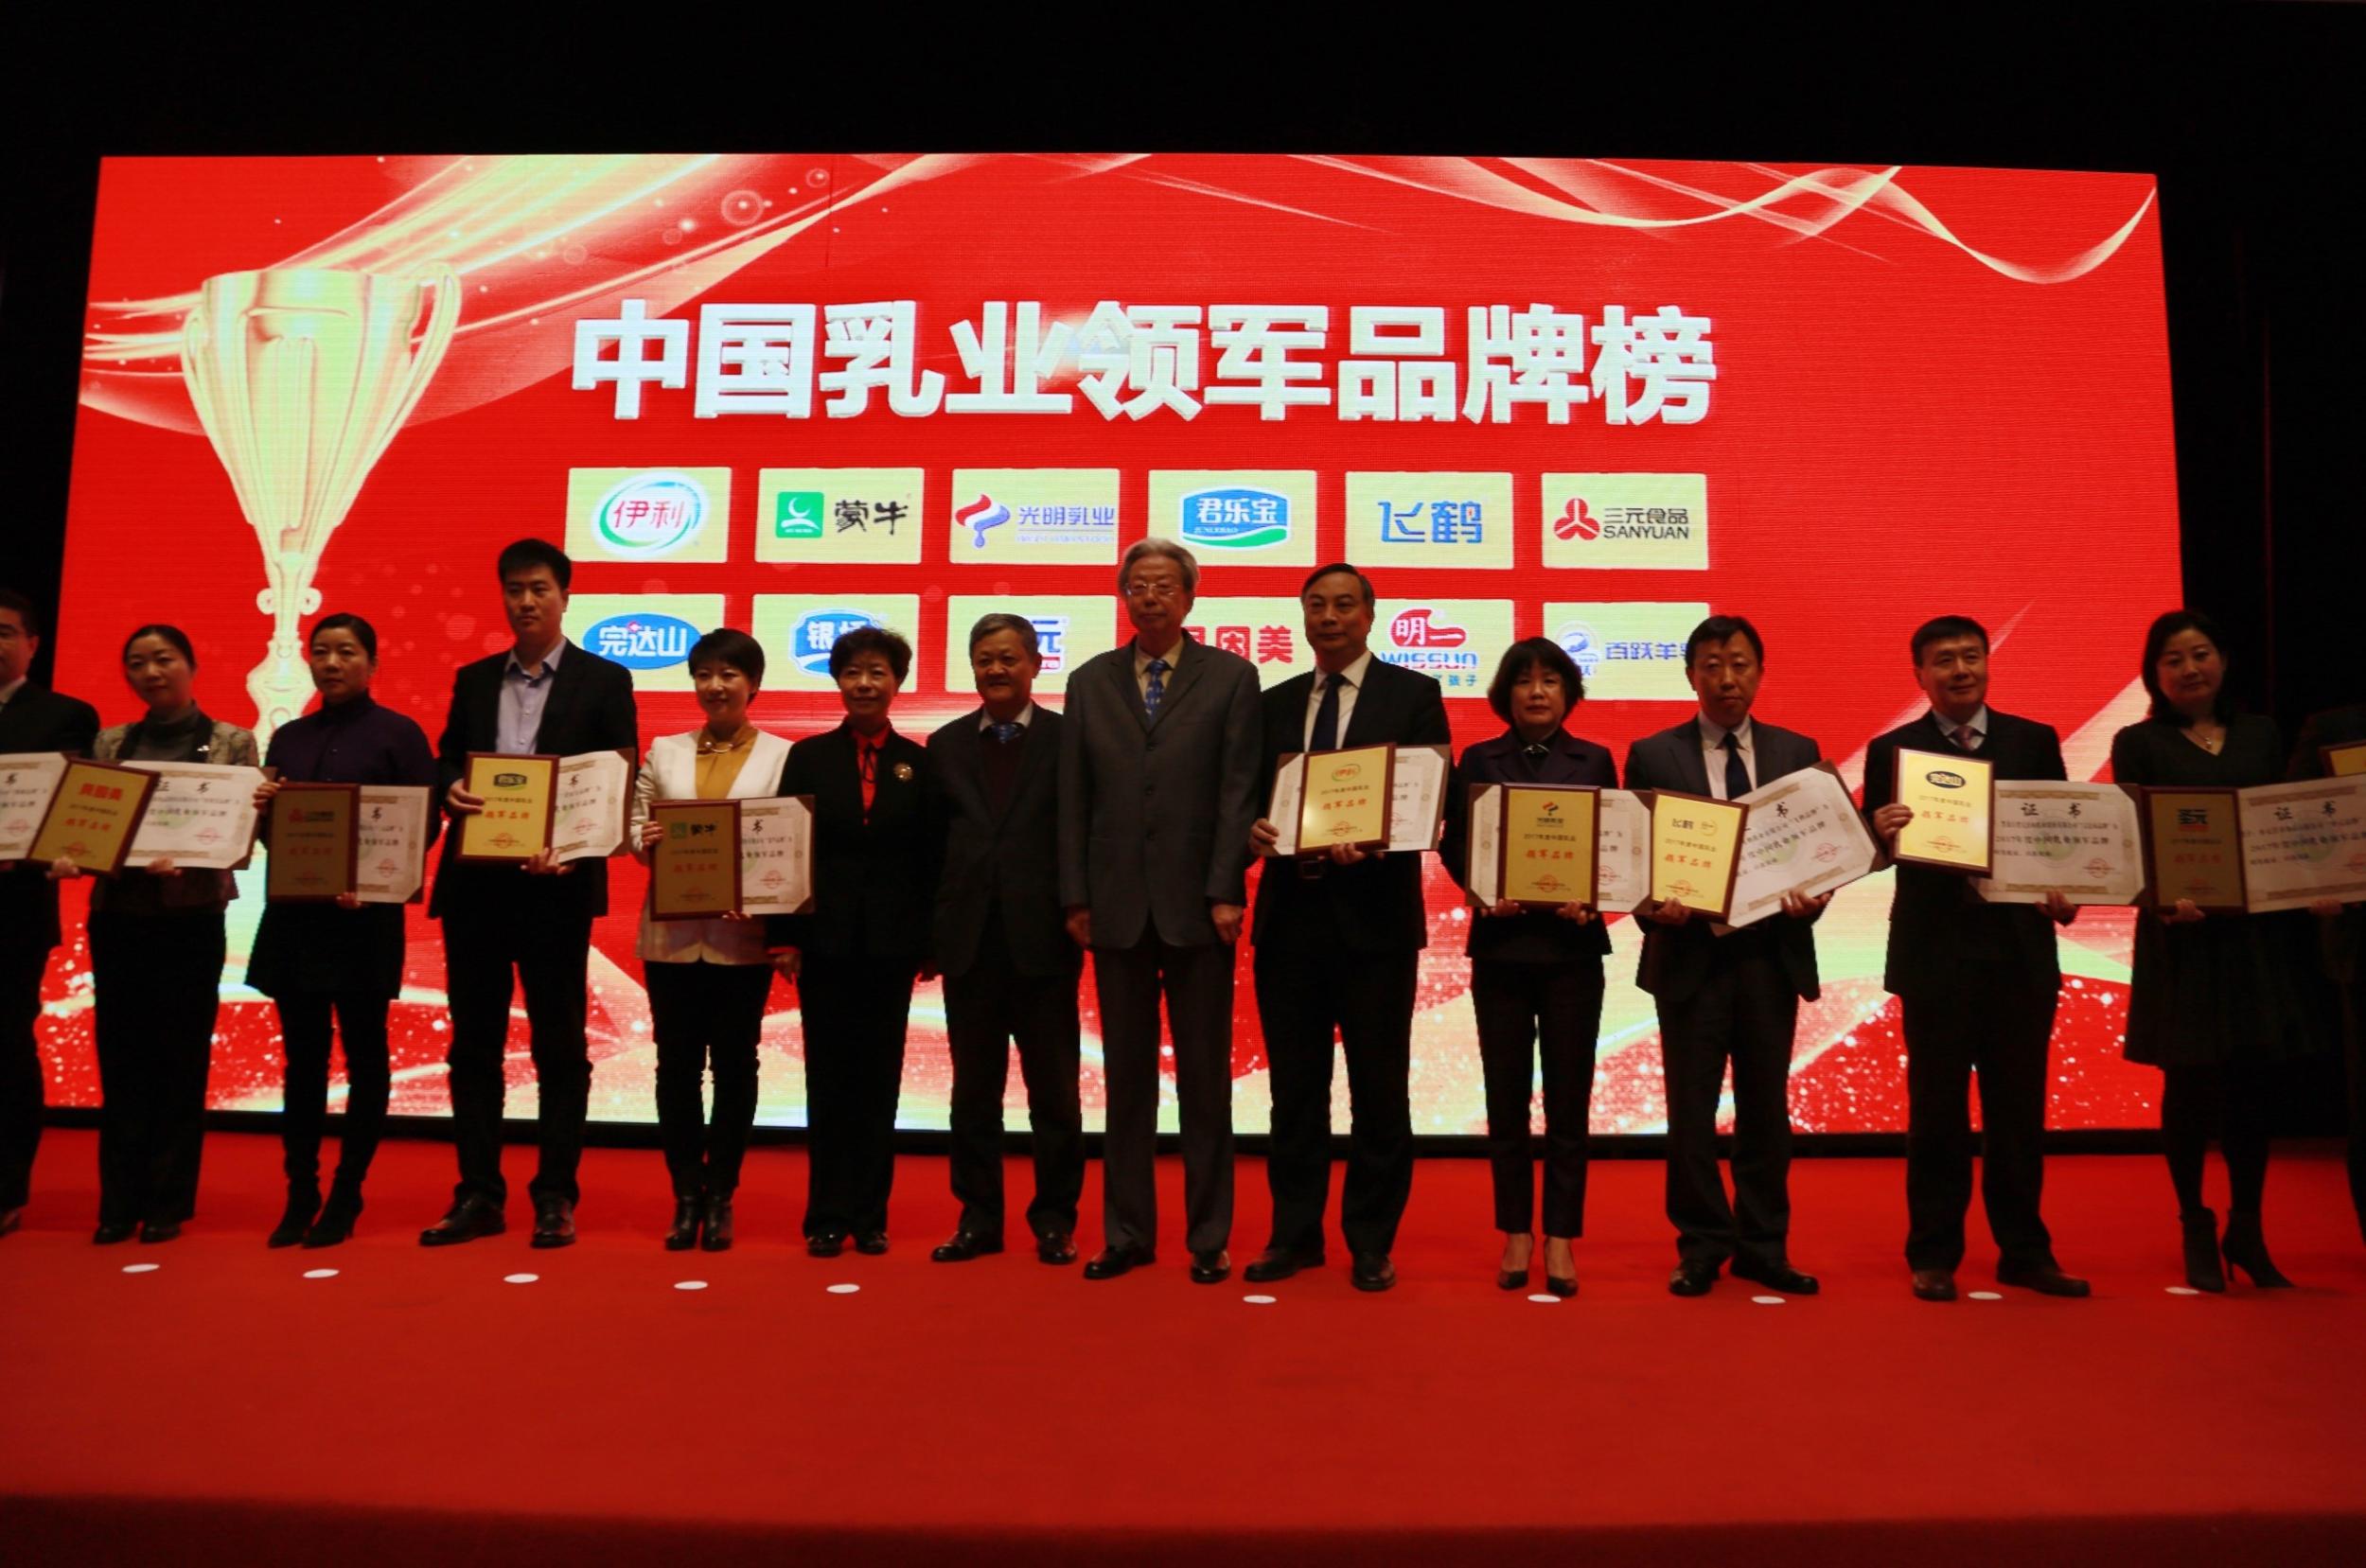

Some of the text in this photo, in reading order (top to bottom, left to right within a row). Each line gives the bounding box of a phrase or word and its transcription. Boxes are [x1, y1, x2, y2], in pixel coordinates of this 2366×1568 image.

[572, 301, 1716, 426] 中国乳业领军品牌榜
[613, 500, 685, 529] 伊利
[834, 499, 909, 534] 蒙牛
[1017, 505, 1115, 526] 光明乳业
[1196, 498, 1278, 524] 君乐宝
[1378, 501, 1482, 543] 飞鹤
[1604, 508, 1688, 524] 三元食品
[1603, 525, 1689, 539] SANYUAN
[598, 624, 687, 658] 完达山
[1396, 616, 1463, 646] 明一
